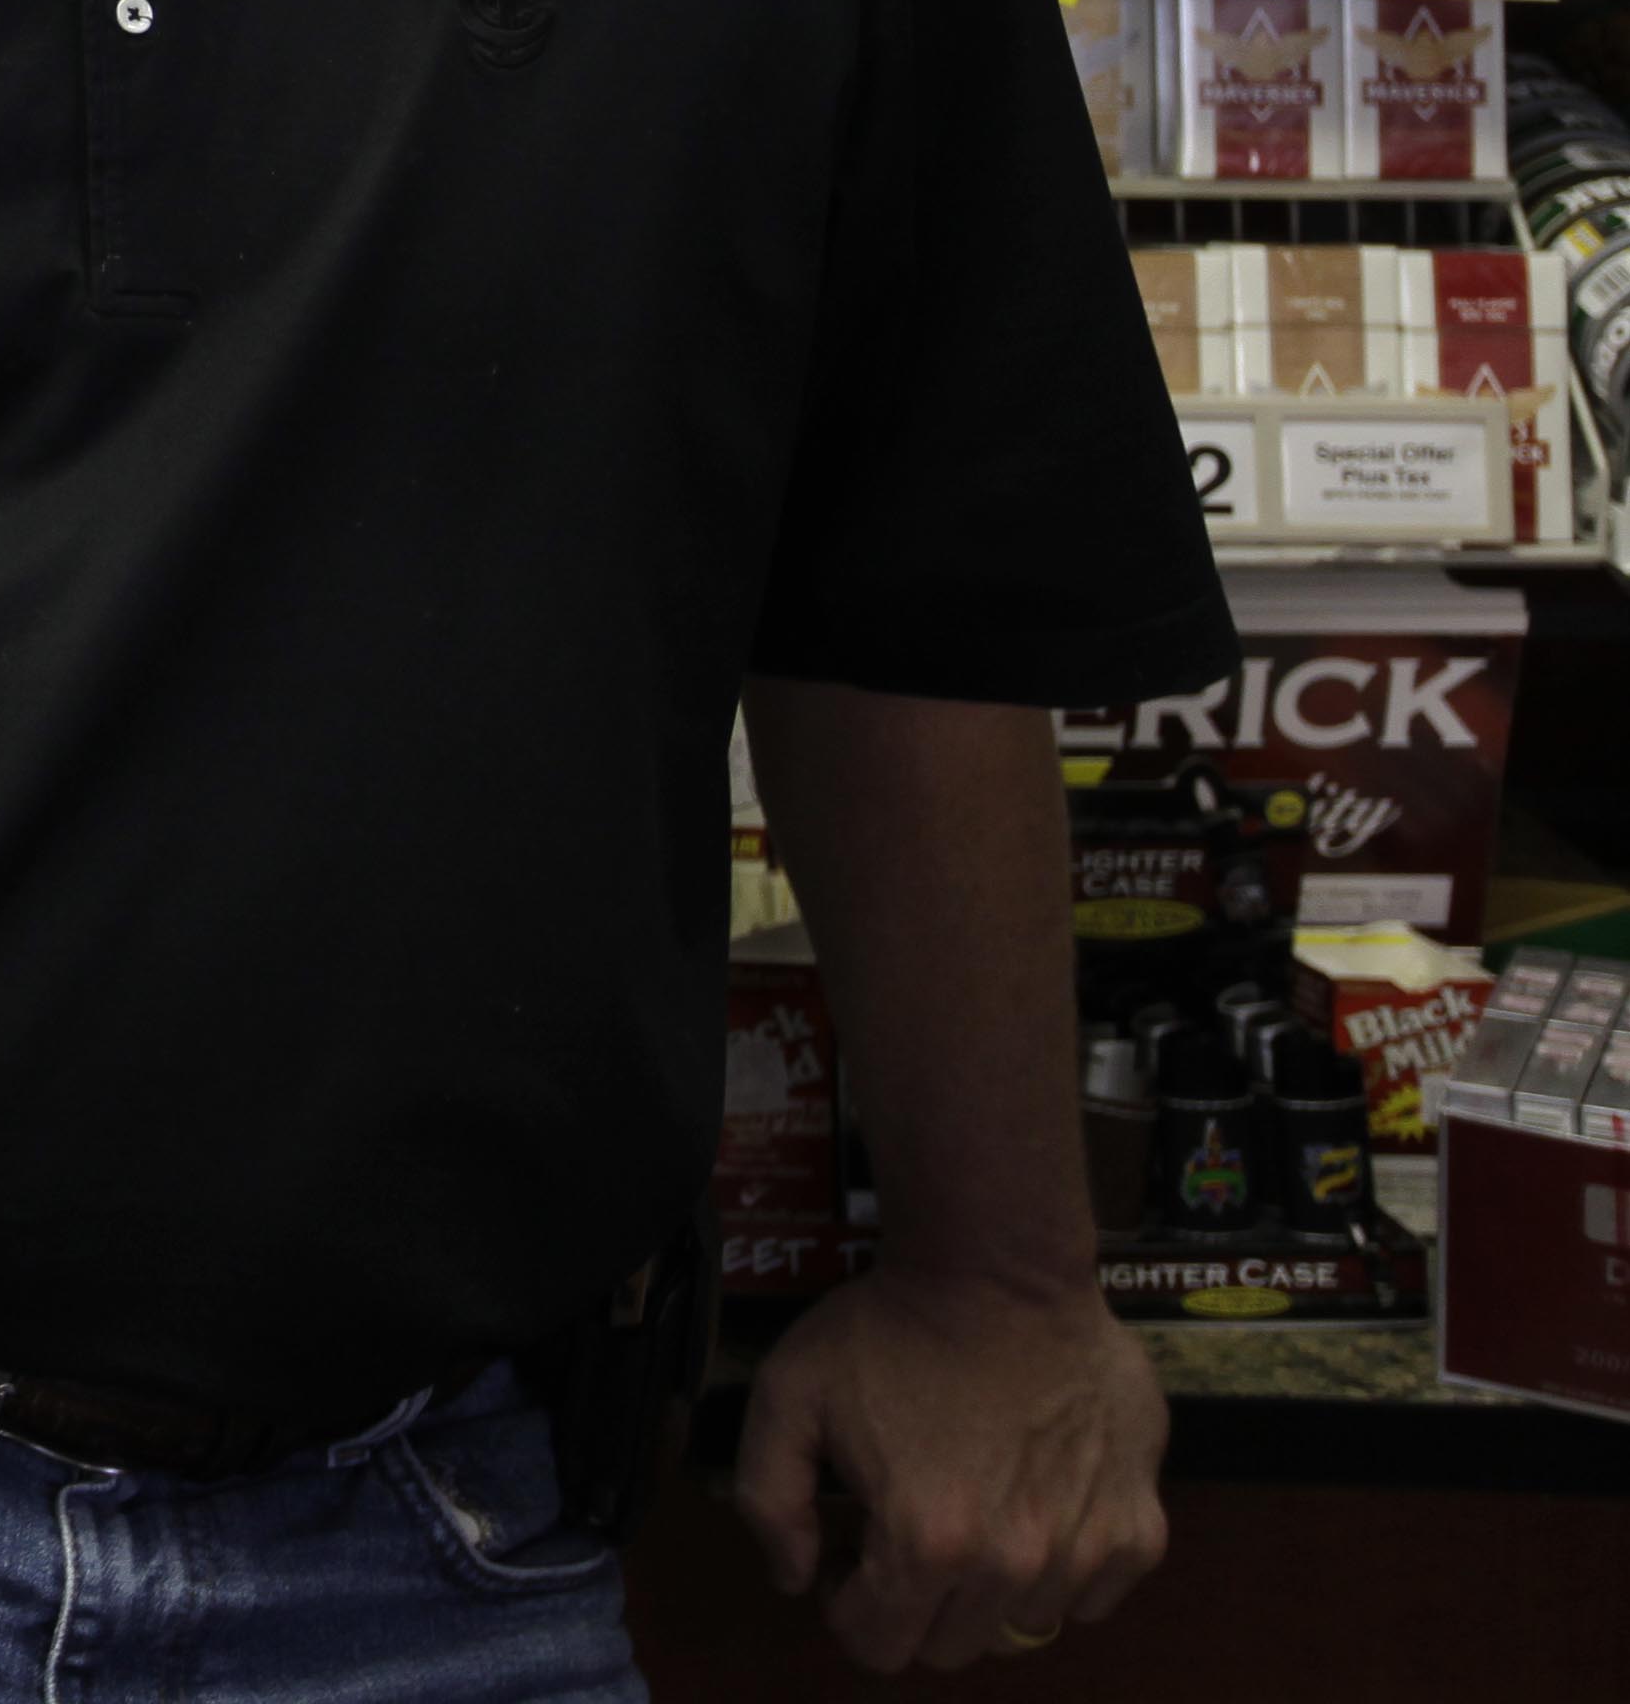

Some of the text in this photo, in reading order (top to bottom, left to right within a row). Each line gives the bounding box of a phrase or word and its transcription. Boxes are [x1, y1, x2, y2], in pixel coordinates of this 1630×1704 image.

[1316, 442, 1455, 464] Special Offer
[1342, 467, 1430, 485] Plus Tax
[1098, 1263, 1235, 1288] IGHTER
